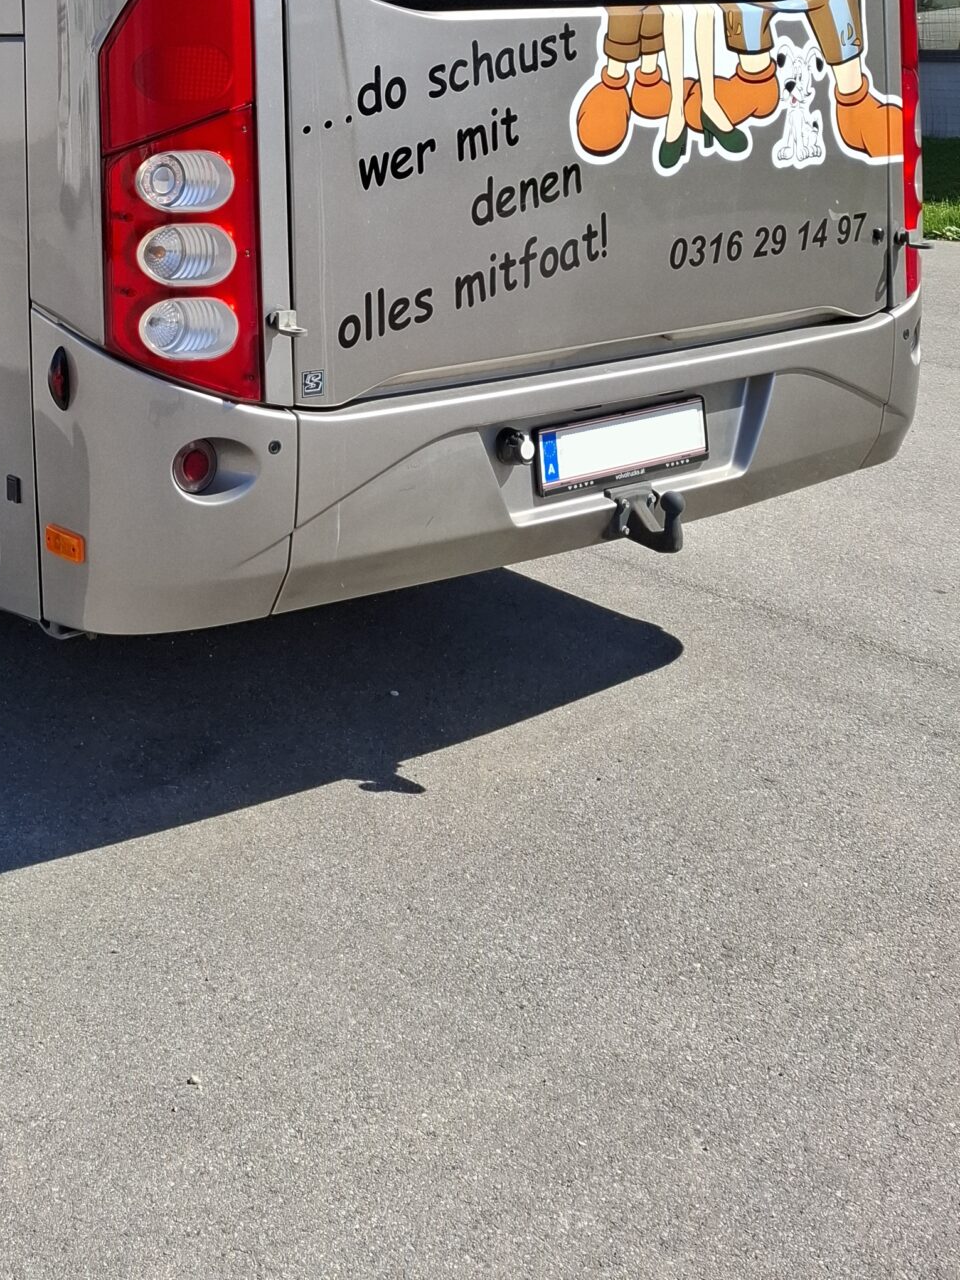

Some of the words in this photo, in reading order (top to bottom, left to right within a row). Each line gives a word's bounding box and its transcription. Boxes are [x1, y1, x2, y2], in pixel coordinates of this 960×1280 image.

[428, 22, 578, 99] schaust
[358, 138, 436, 191] wer
[456, 107, 520, 162] mit
[471, 163, 582, 226] denen
[669, 230, 744, 270] 0316
[752, 224, 787, 258] 29
[798, 218, 828, 251] 14
[836, 212, 868, 245] 97
[338, 287, 434, 349] olles
[455, 213, 609, 310] mitfoat!
[548, 463, 556, 475] A
